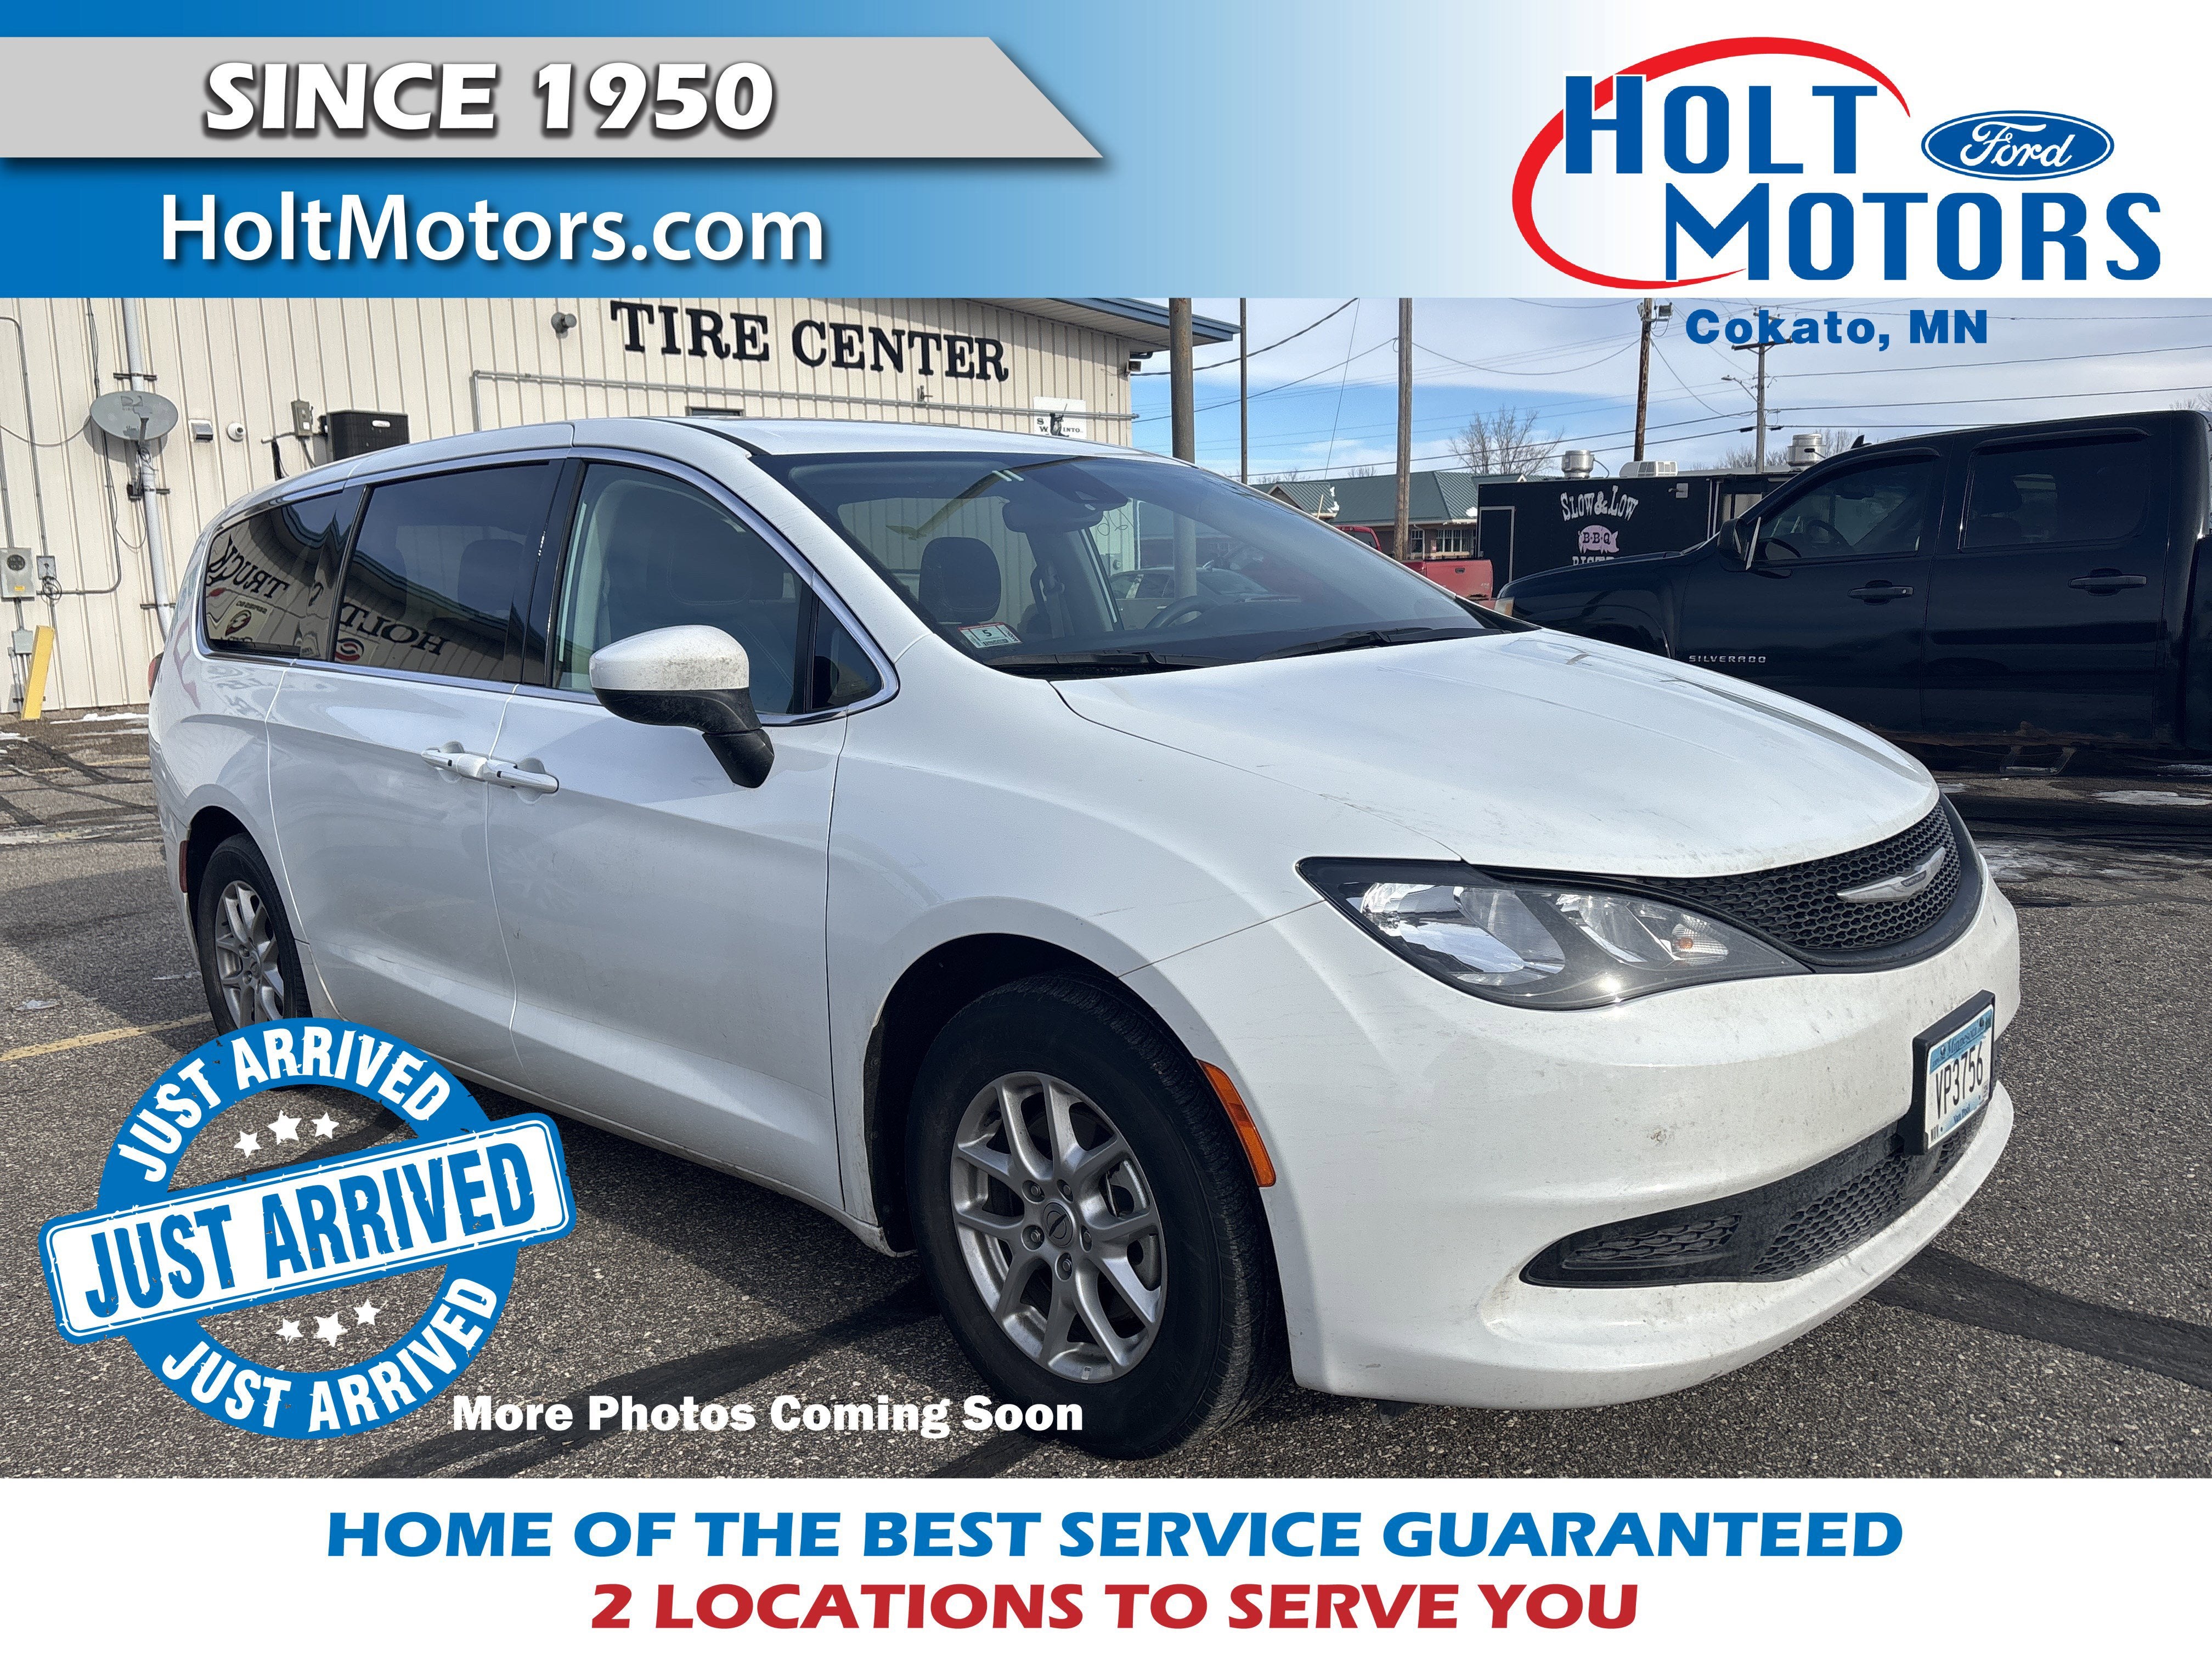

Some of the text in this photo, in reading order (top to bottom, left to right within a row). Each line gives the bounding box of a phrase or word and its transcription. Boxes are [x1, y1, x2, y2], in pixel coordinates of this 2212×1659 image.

[610, 300, 1009, 382] TIRE CENTER
[1689, 655, 1767, 663] SILVERADO
[1936, 1041, 1983, 1120] VP3756
